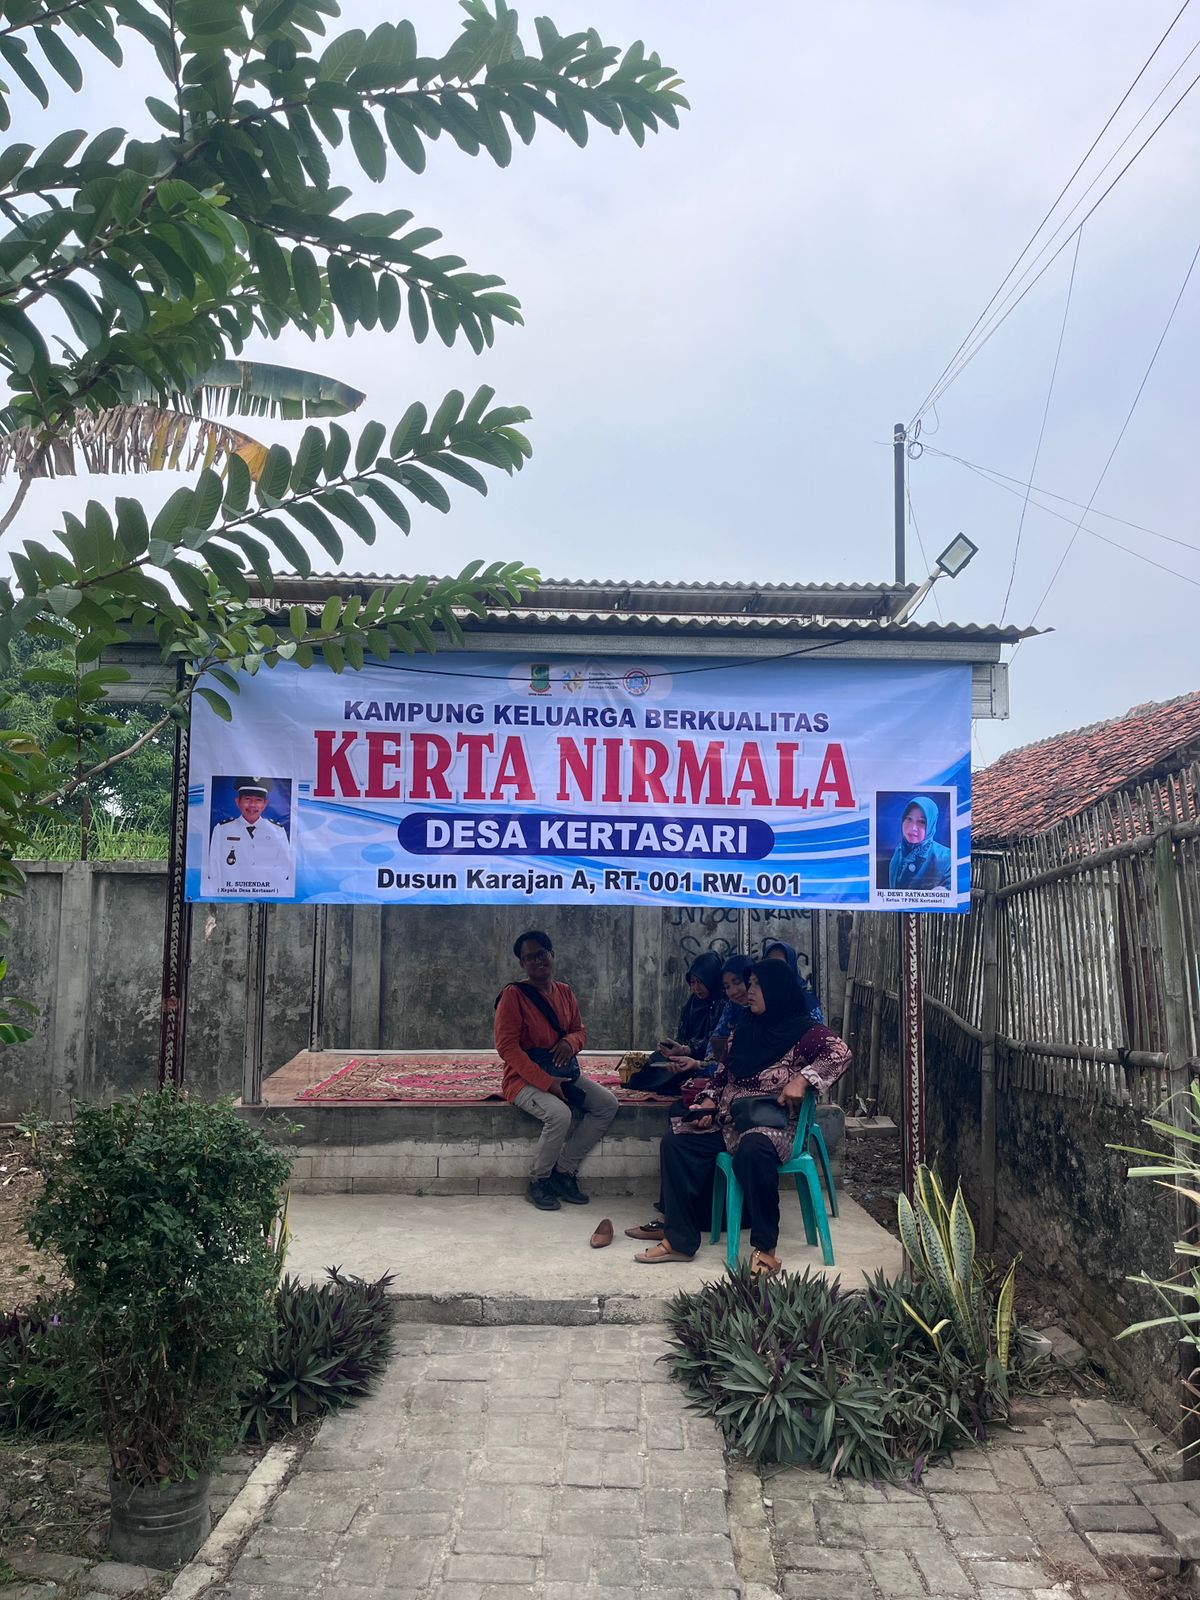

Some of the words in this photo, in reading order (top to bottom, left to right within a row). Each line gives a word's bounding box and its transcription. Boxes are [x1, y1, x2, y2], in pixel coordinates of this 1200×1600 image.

[344, 700, 484, 725] KAMPUNG
[494, 705, 636, 729] KELUARGA
[645, 709, 830, 732] BERKUALITAS
[313, 730, 536, 801] KERTA
[556, 736, 856, 809] NIRMALA
[426, 819, 528, 849] DESA
[540, 821, 748, 854] KERTASARI
[377, 868, 457, 889] Dusun
[466, 869, 563, 894] Karajan
[571, 870, 596, 894] A,
[605, 870, 641, 890] RT.
[649, 871, 692, 892] 001
[703, 873, 748, 893] RW.
[756, 874, 800, 895] 001
